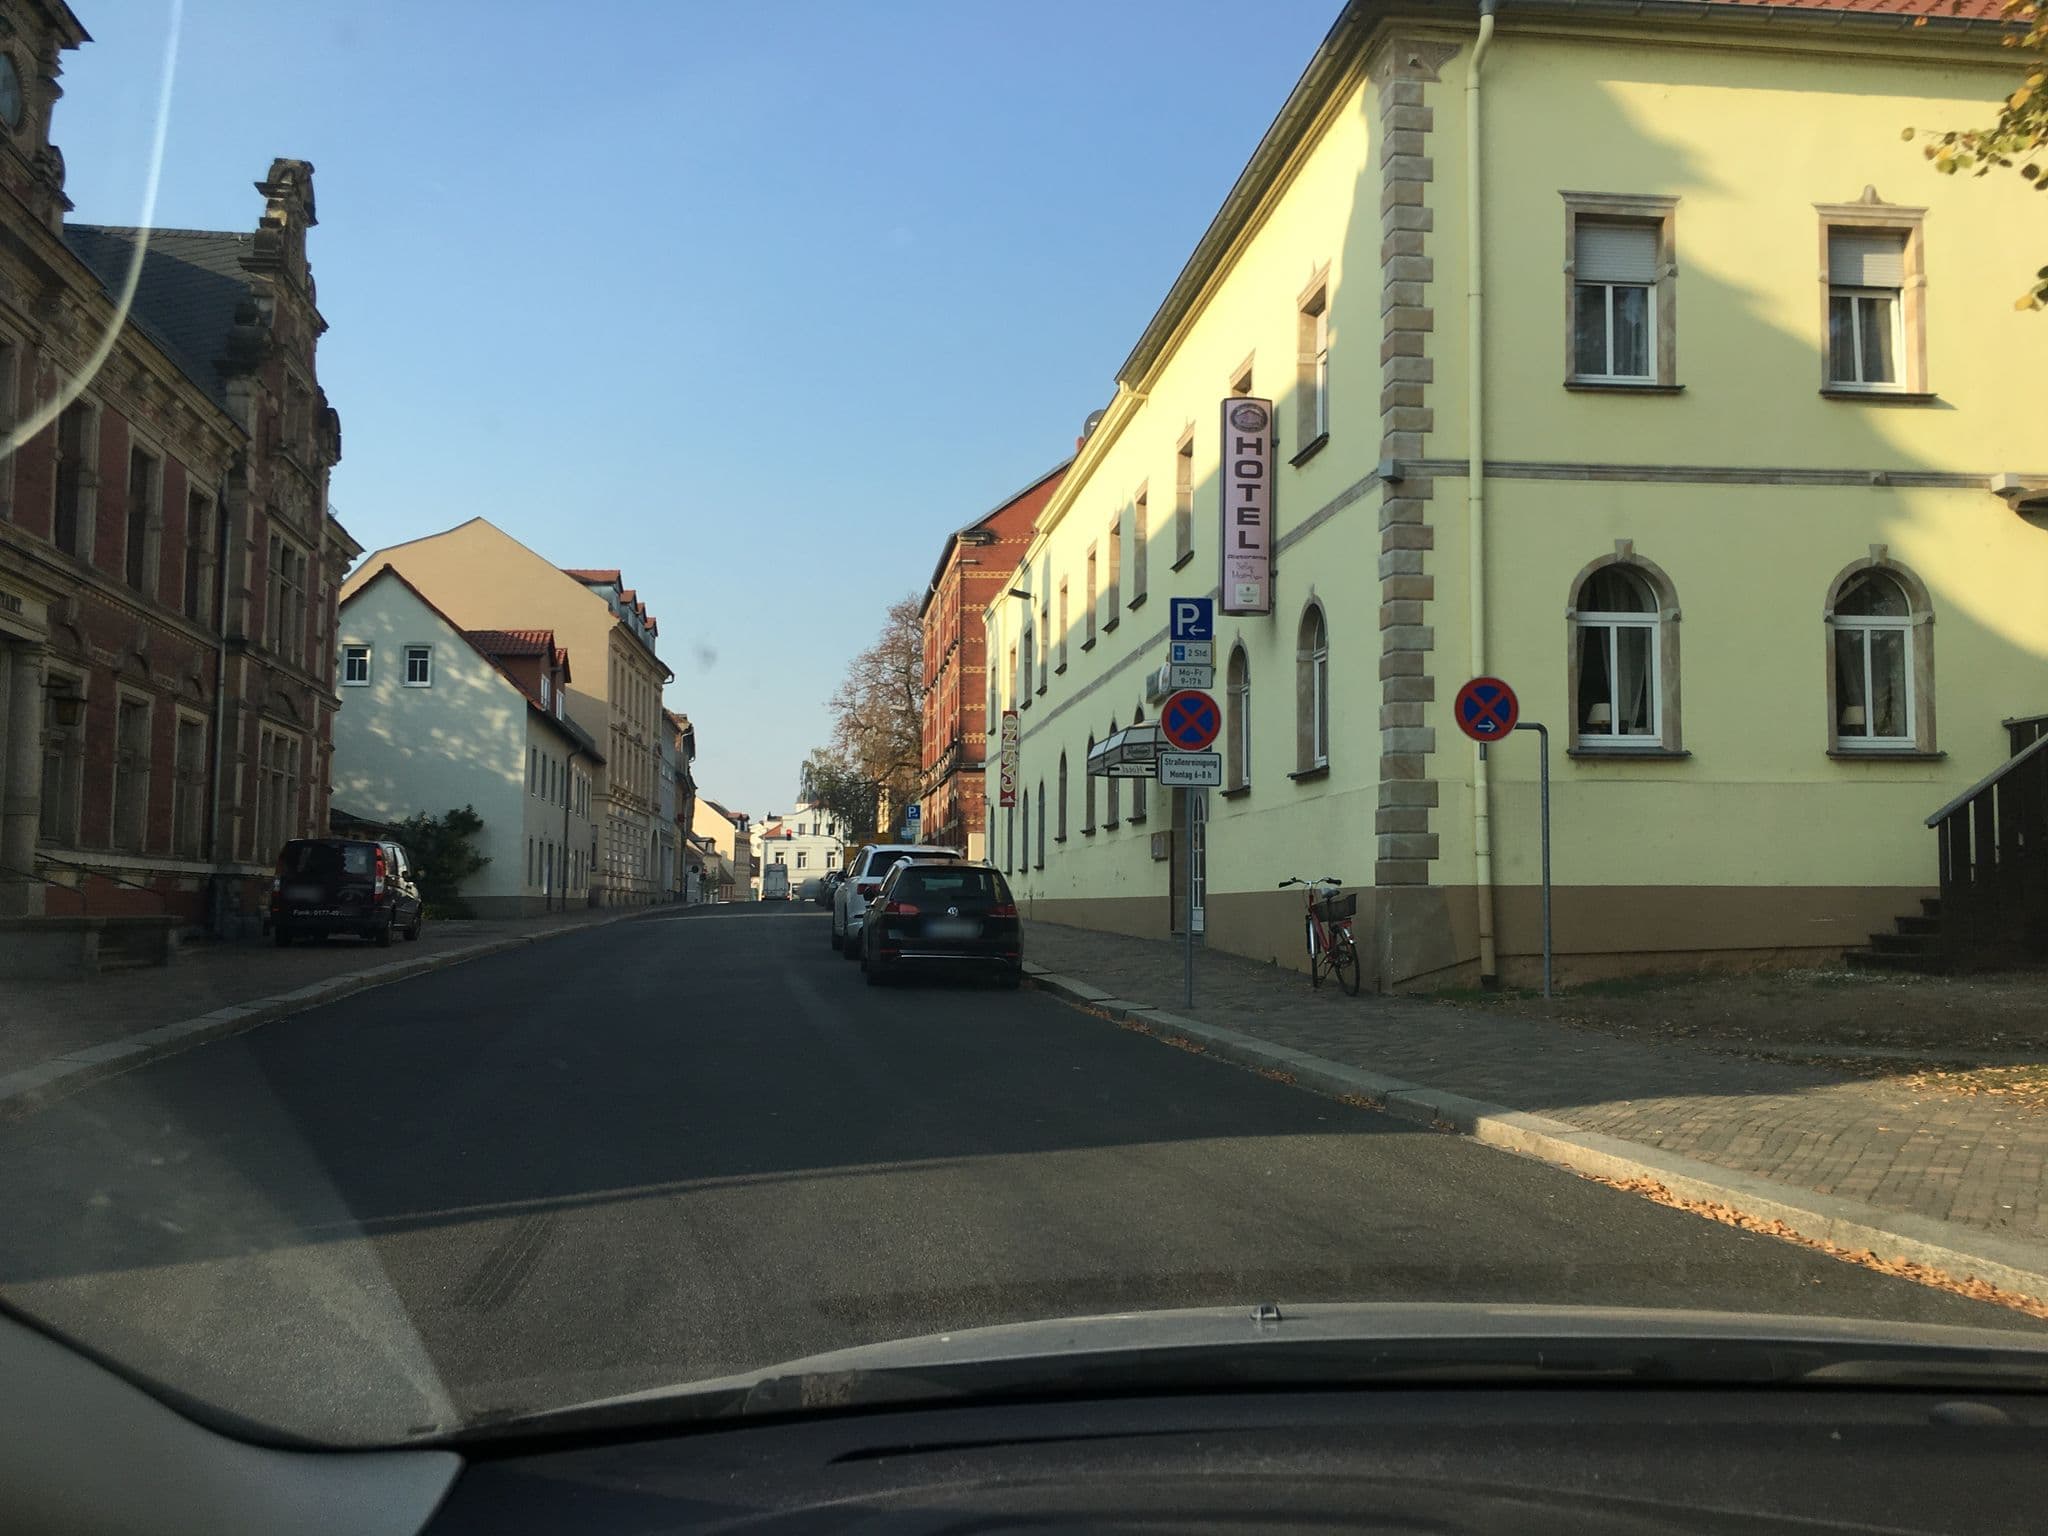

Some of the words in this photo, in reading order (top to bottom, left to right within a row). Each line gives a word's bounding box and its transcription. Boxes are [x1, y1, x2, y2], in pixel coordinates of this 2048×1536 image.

[1235, 437, 1263, 550] HOTEL
[1177, 603, 1200, 636] P
[1188, 649, 1193, 657] 2
[1001, 714, 1017, 793] CASINO
[1164, 758, 1217, 768] Straßenreinigung
[1170, 771, 1192, 780] Montag
